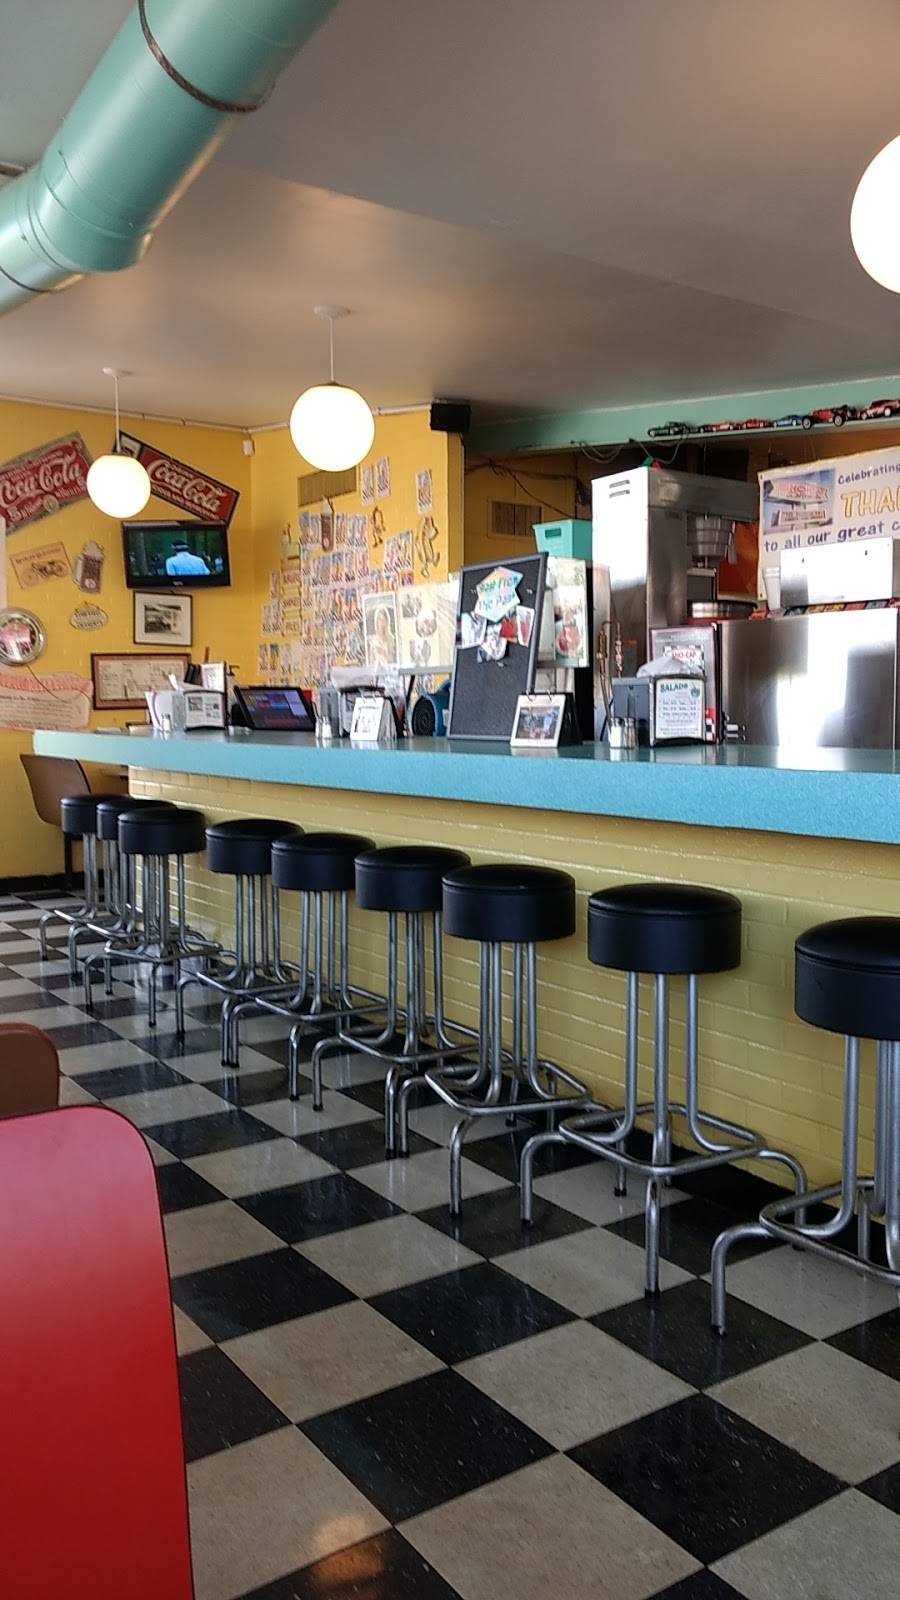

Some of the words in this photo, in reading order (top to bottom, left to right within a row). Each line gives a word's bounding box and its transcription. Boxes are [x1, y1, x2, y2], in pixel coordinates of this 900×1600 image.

[841, 483, 900, 518] THA
[764, 540, 778, 552] to
[784, 535, 800, 549] all
[807, 531, 831, 545] our
[837, 521, 885, 542] great
